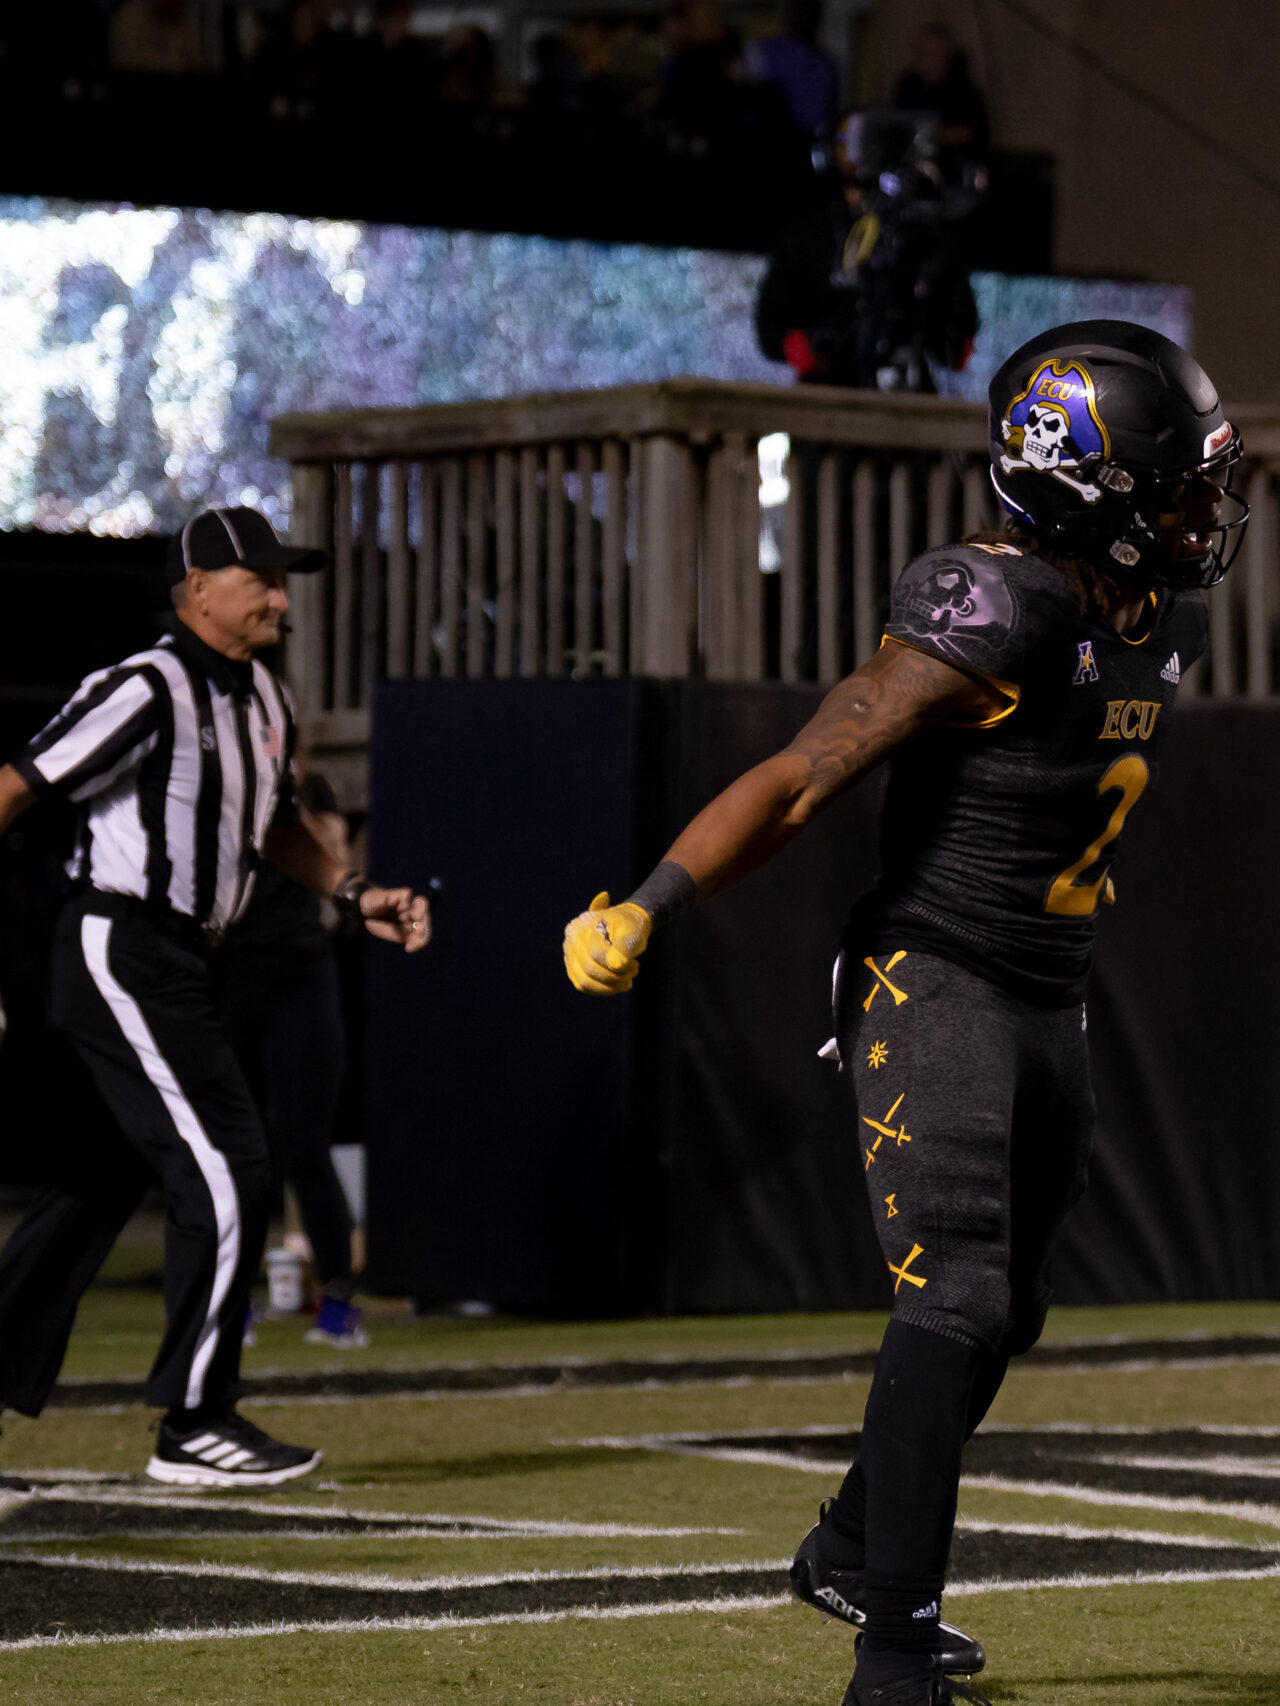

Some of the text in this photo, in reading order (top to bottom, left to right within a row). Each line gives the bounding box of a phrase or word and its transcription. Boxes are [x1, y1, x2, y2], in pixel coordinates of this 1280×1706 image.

[1036, 379, 1077, 401] ECU
[1097, 700, 1162, 740] ECU
[201, 726, 217, 751] S
[1043, 752, 1150, 919] 2
